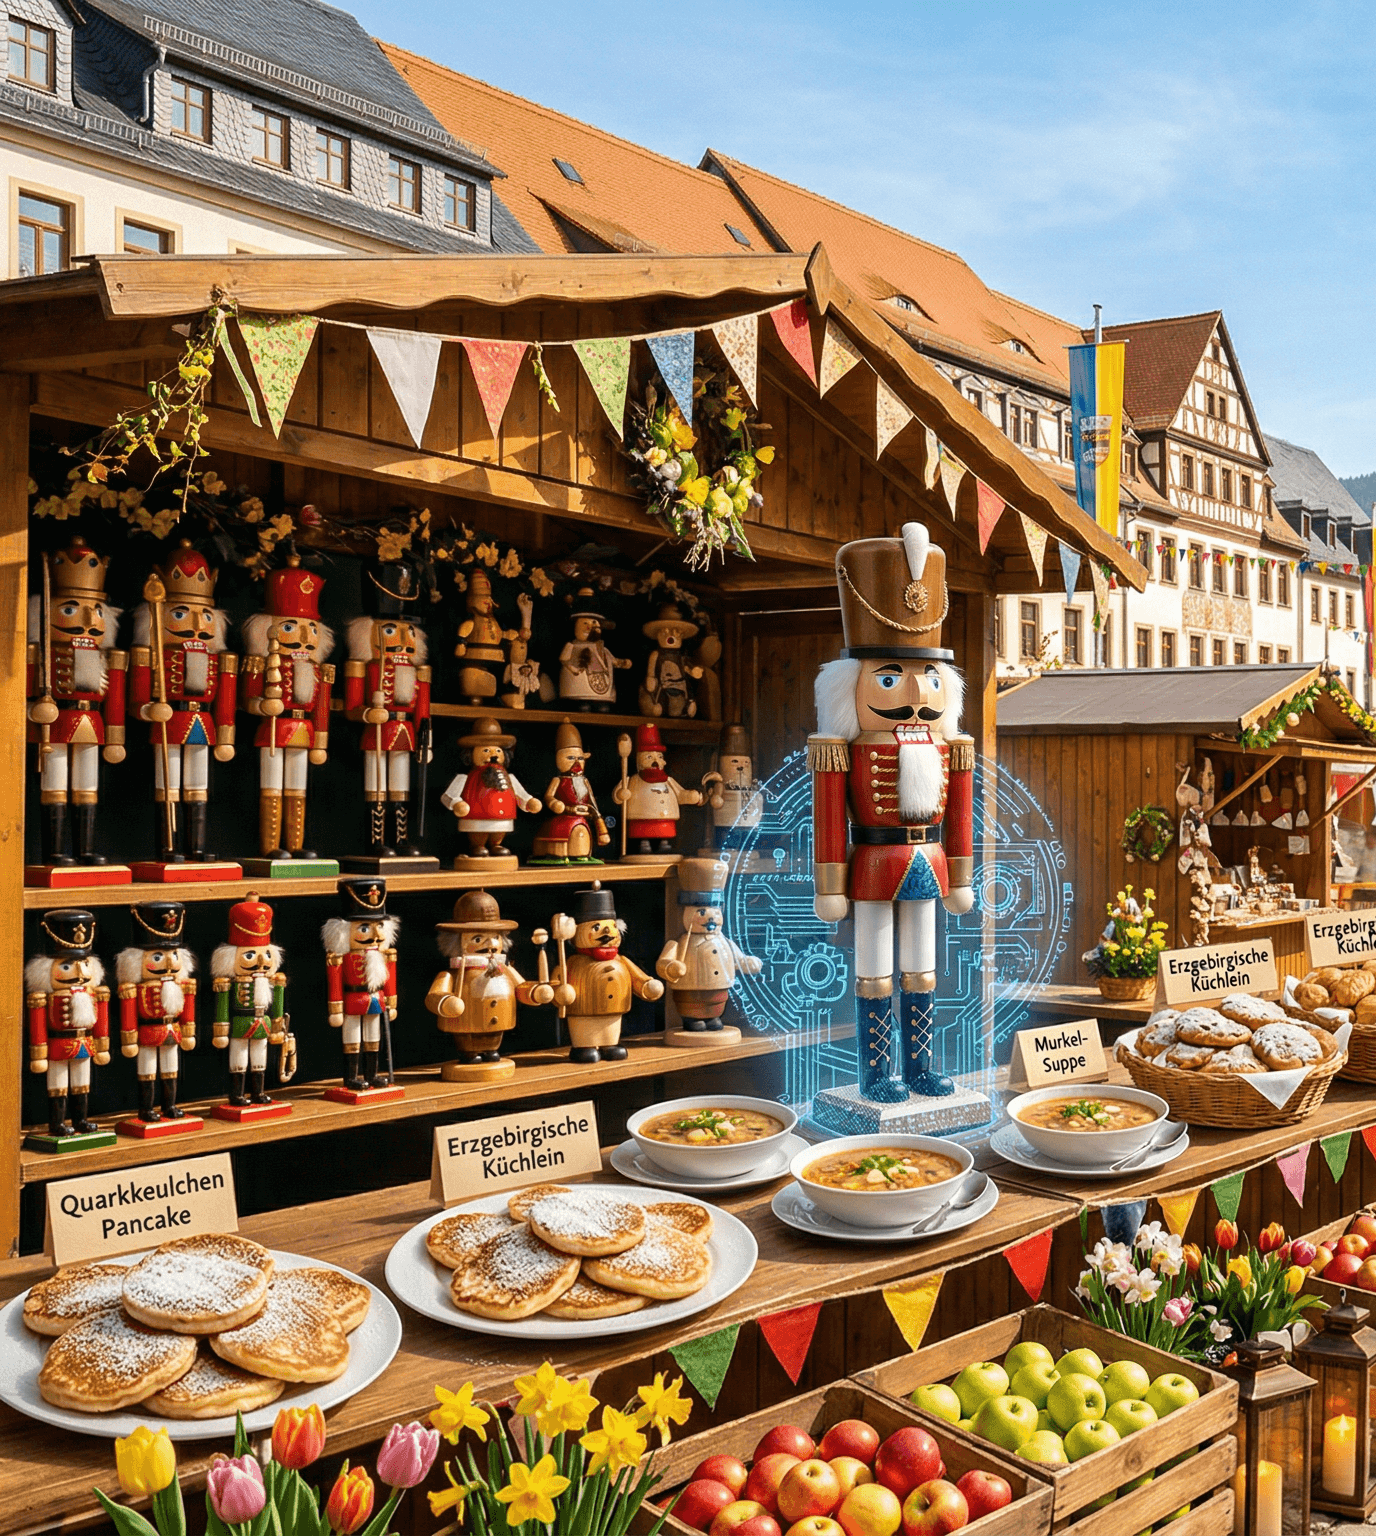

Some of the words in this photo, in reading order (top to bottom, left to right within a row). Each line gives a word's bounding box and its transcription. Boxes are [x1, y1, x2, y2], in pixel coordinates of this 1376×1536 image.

[1169, 947, 1269, 976] Erzgebirgische
[1191, 970, 1250, 993] Küchlein
[1034, 1029, 1089, 1053] Murkel-
[1042, 1055, 1087, 1075] Suppe
[447, 1115, 589, 1157] Erzgebirgische
[482, 1148, 565, 1179] Küchlein
[60, 1171, 225, 1219] Quarkkeulchen
[102, 1206, 191, 1240] Pancake
